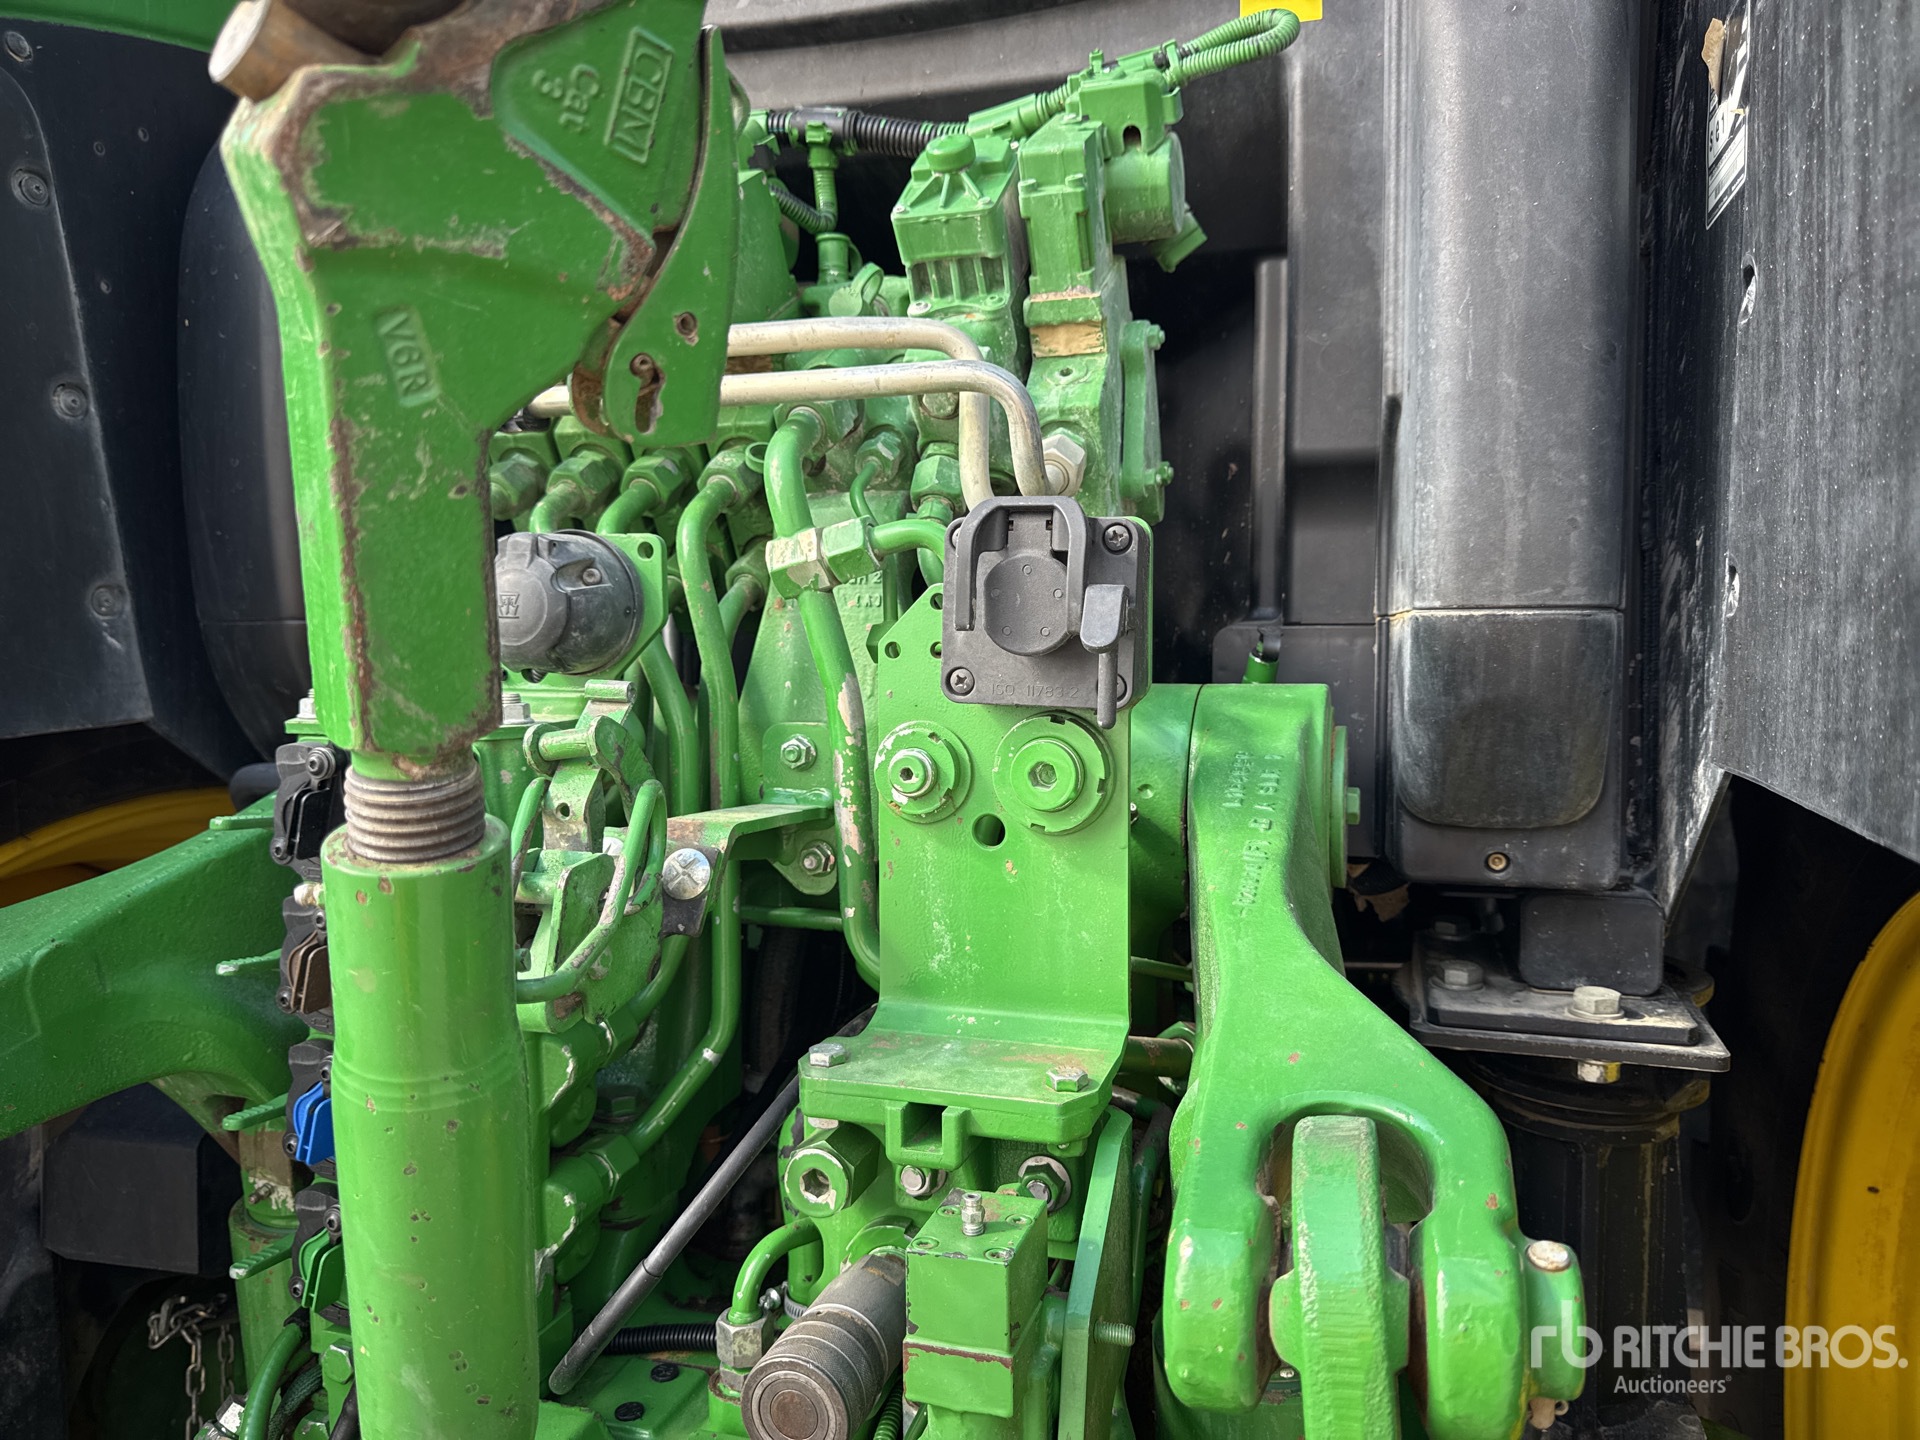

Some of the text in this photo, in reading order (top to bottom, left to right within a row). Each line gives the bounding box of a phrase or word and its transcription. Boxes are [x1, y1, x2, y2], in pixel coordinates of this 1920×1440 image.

[558, 63, 600, 134] Cat
[612, 46, 665, 150] CBM
[991, 682, 1016, 698] ISO
